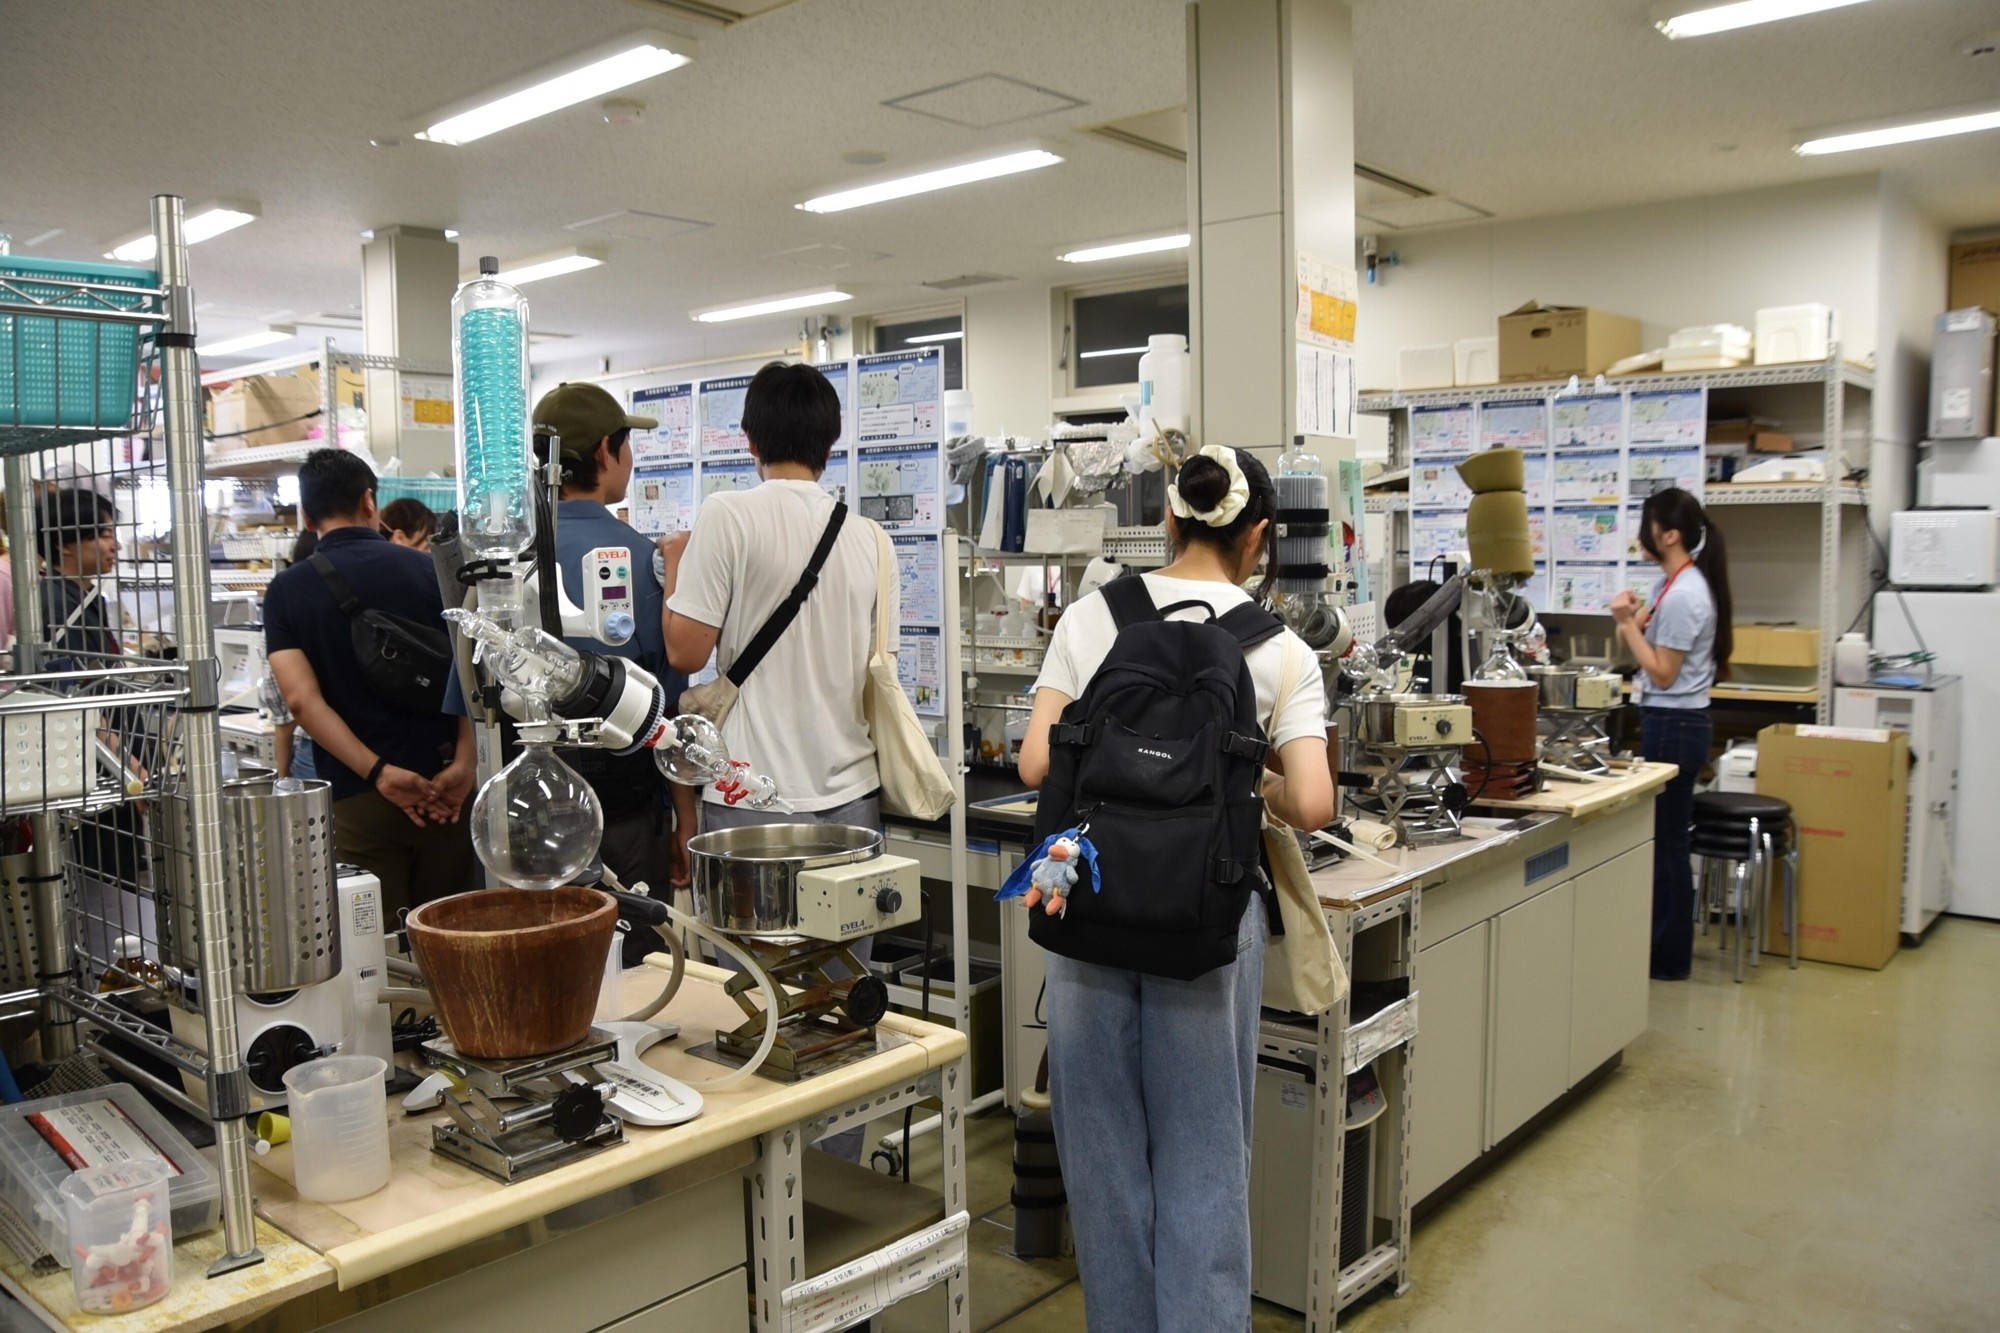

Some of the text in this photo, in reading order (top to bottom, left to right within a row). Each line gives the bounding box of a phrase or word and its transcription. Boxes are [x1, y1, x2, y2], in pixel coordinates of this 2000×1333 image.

[598, 551, 627, 559] EYELA
[1137, 747, 1173, 760] KANGOL
[841, 920, 865, 931] EYELA
